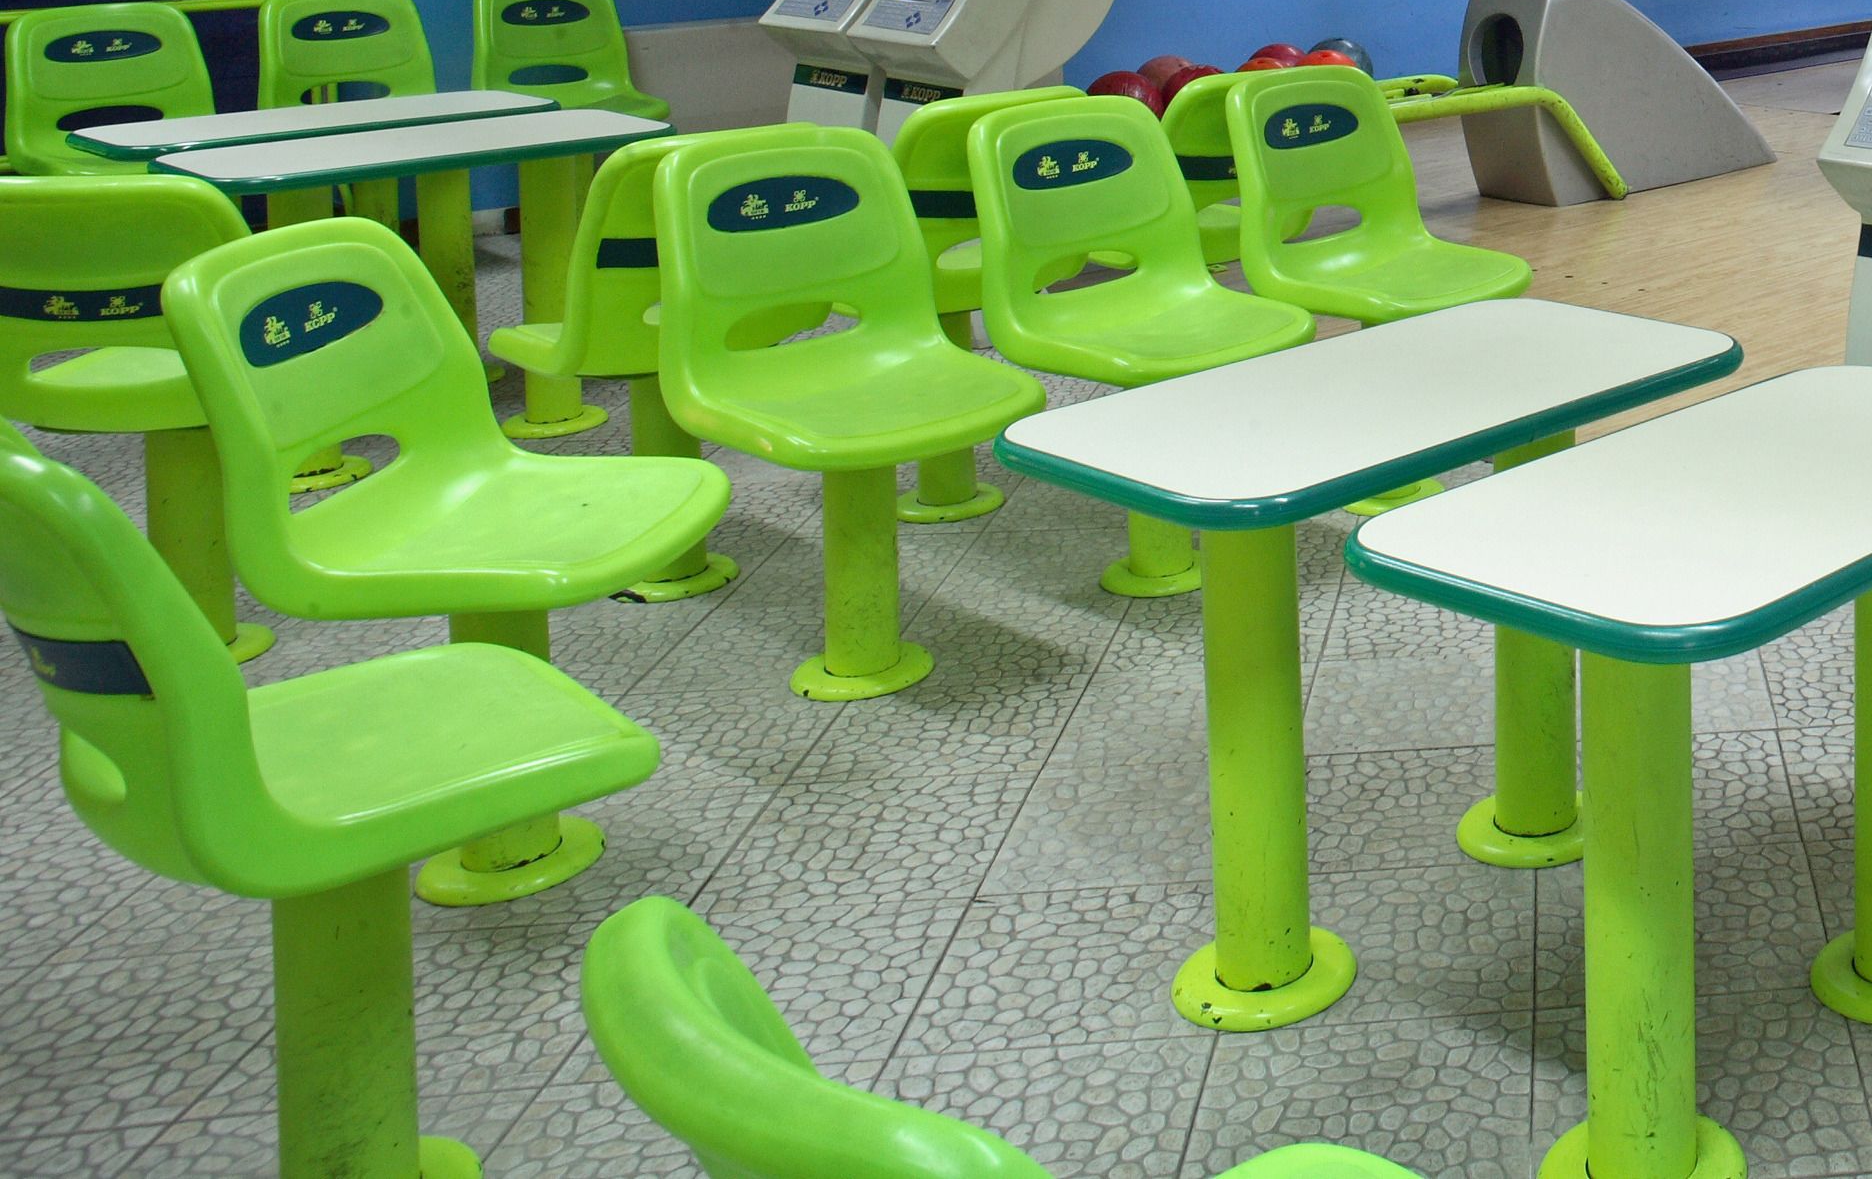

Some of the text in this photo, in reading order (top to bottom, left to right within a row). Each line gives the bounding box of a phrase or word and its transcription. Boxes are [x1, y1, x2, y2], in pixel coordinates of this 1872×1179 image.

[820, 72, 848, 87] KOPP
[911, 86, 941, 102] KOPP
[1072, 160, 1098, 173] KOPP
[784, 200, 817, 213] KOPP
[100, 305, 140, 316] KOPP
